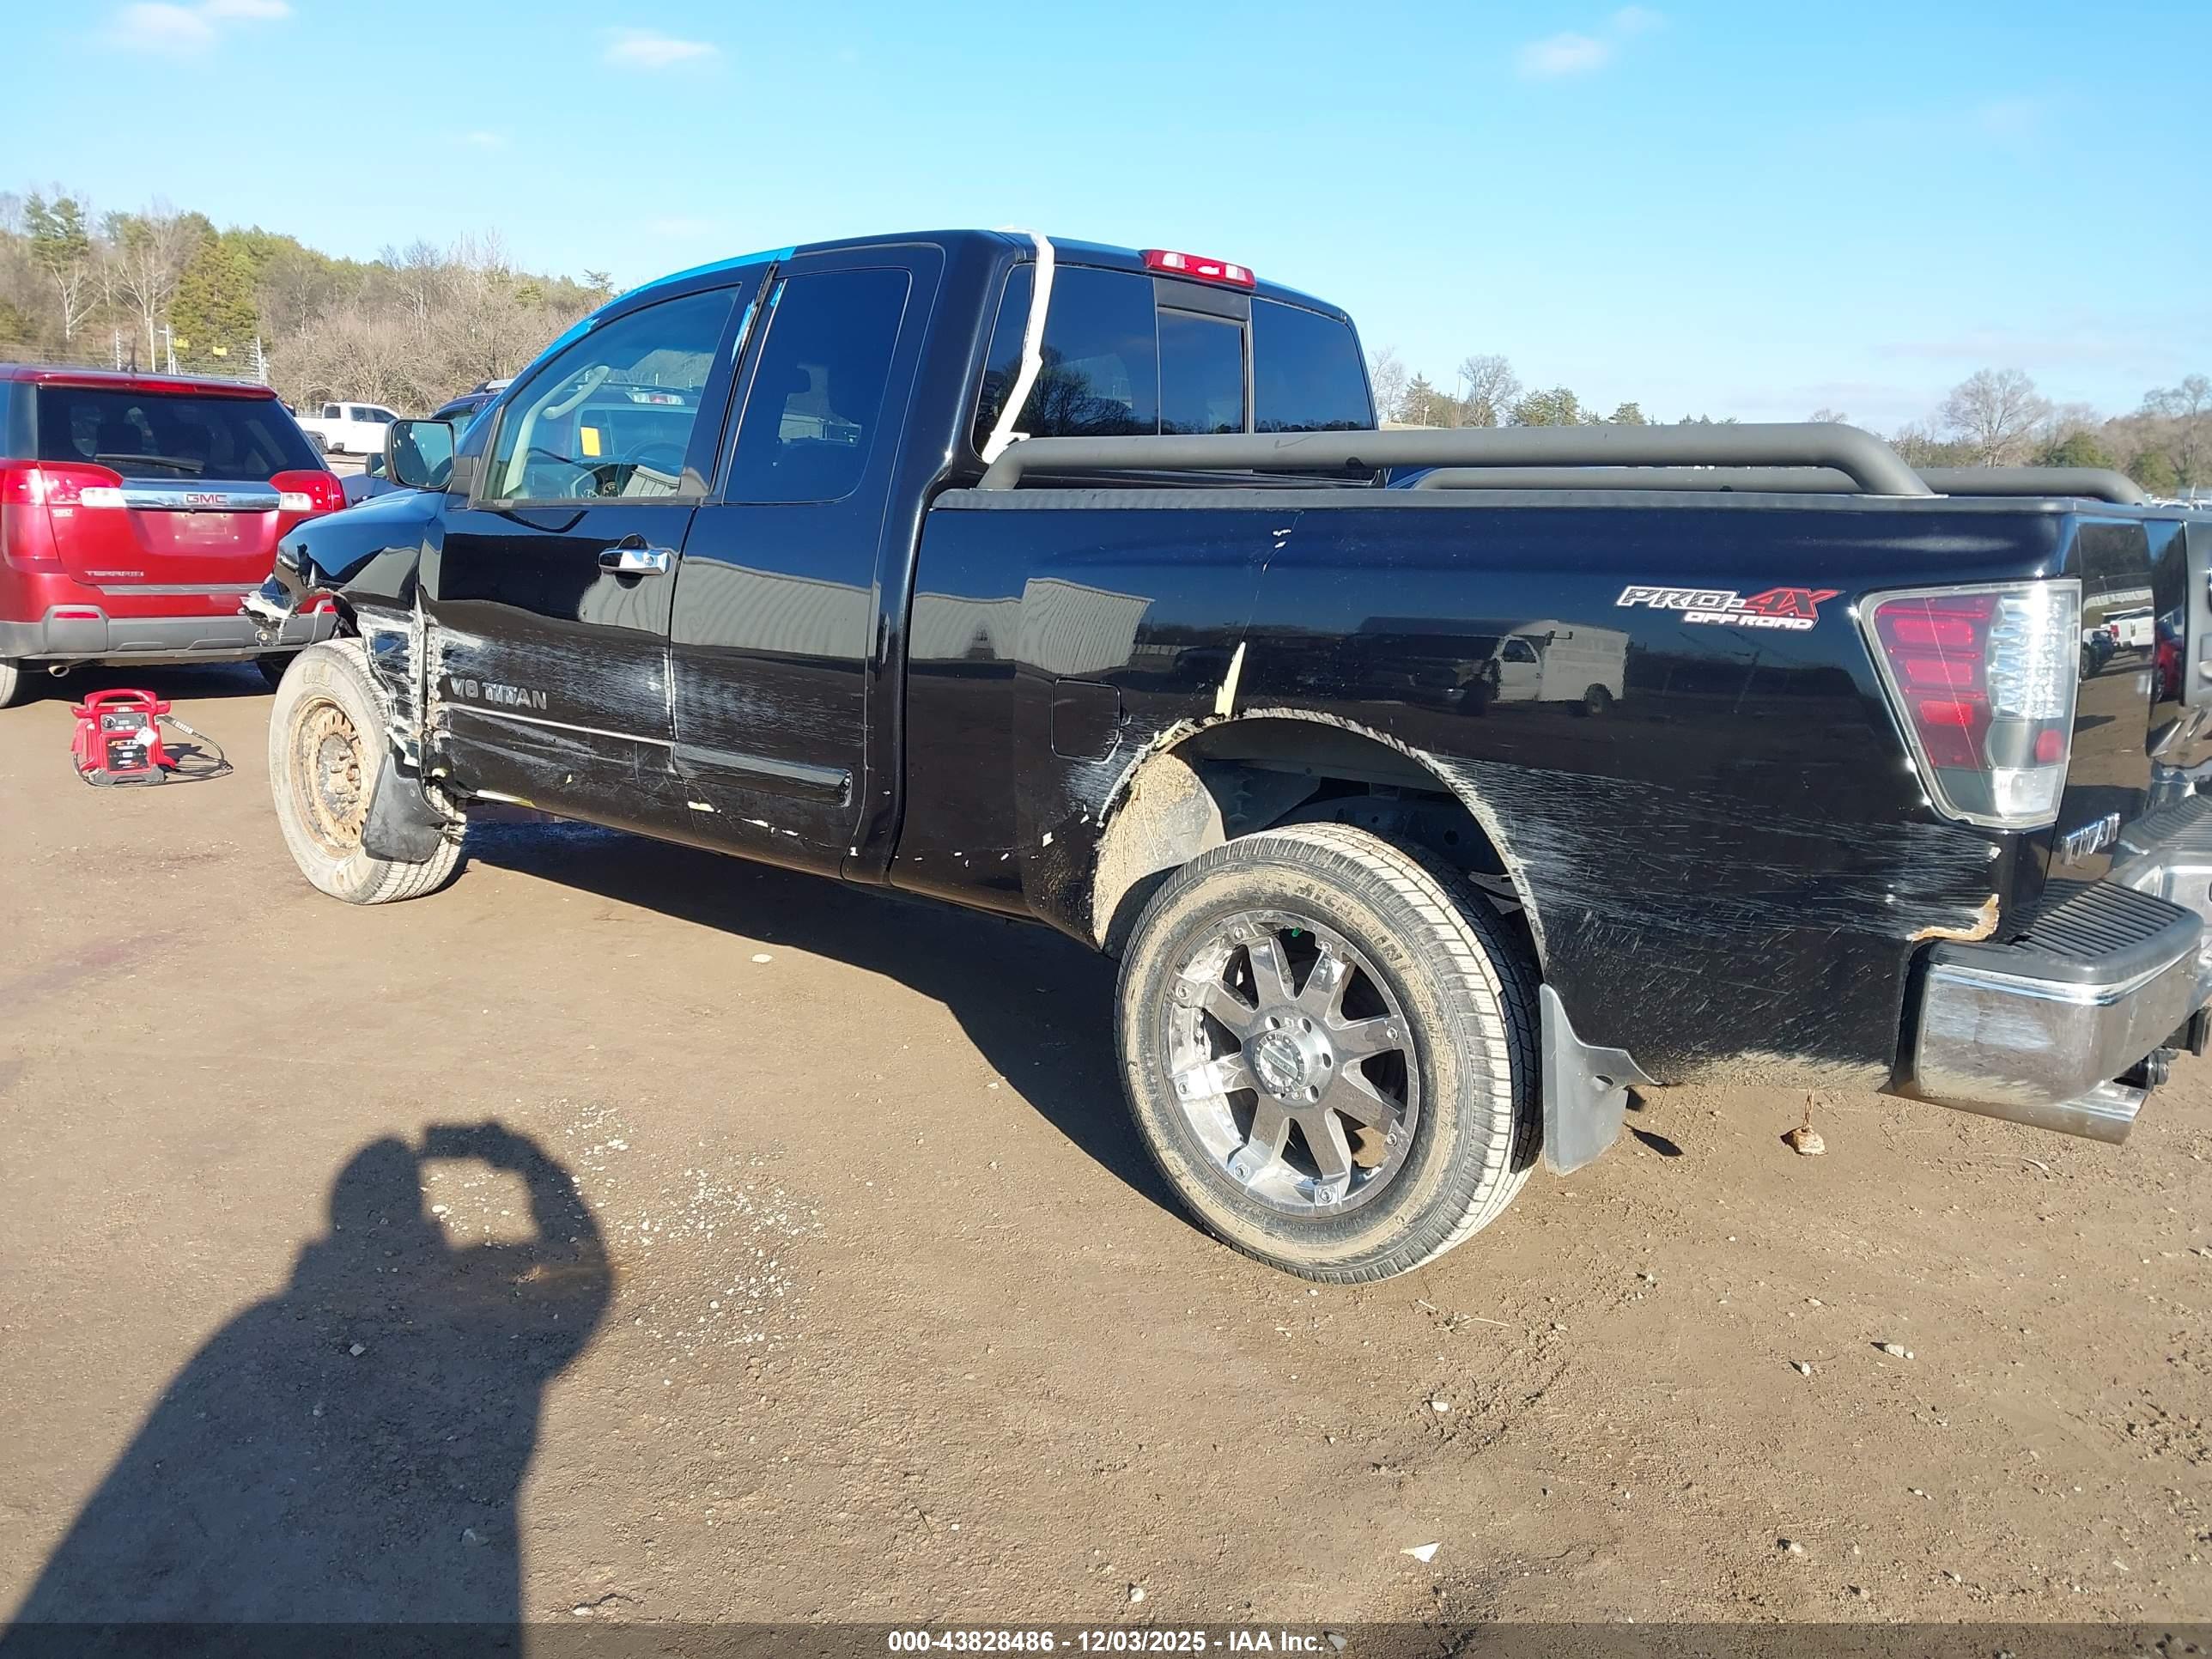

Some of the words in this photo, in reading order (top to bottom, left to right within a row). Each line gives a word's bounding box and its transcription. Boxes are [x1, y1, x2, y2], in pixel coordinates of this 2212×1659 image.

[185, 493, 228, 503] GMC
[1615, 586, 1845, 620] PRO-4X
[1683, 611, 1739, 627] OFF
[1739, 615, 1814, 630] ROAD
[481, 682, 548, 710] TITAN
[2061, 812, 2120, 866] TITAN
